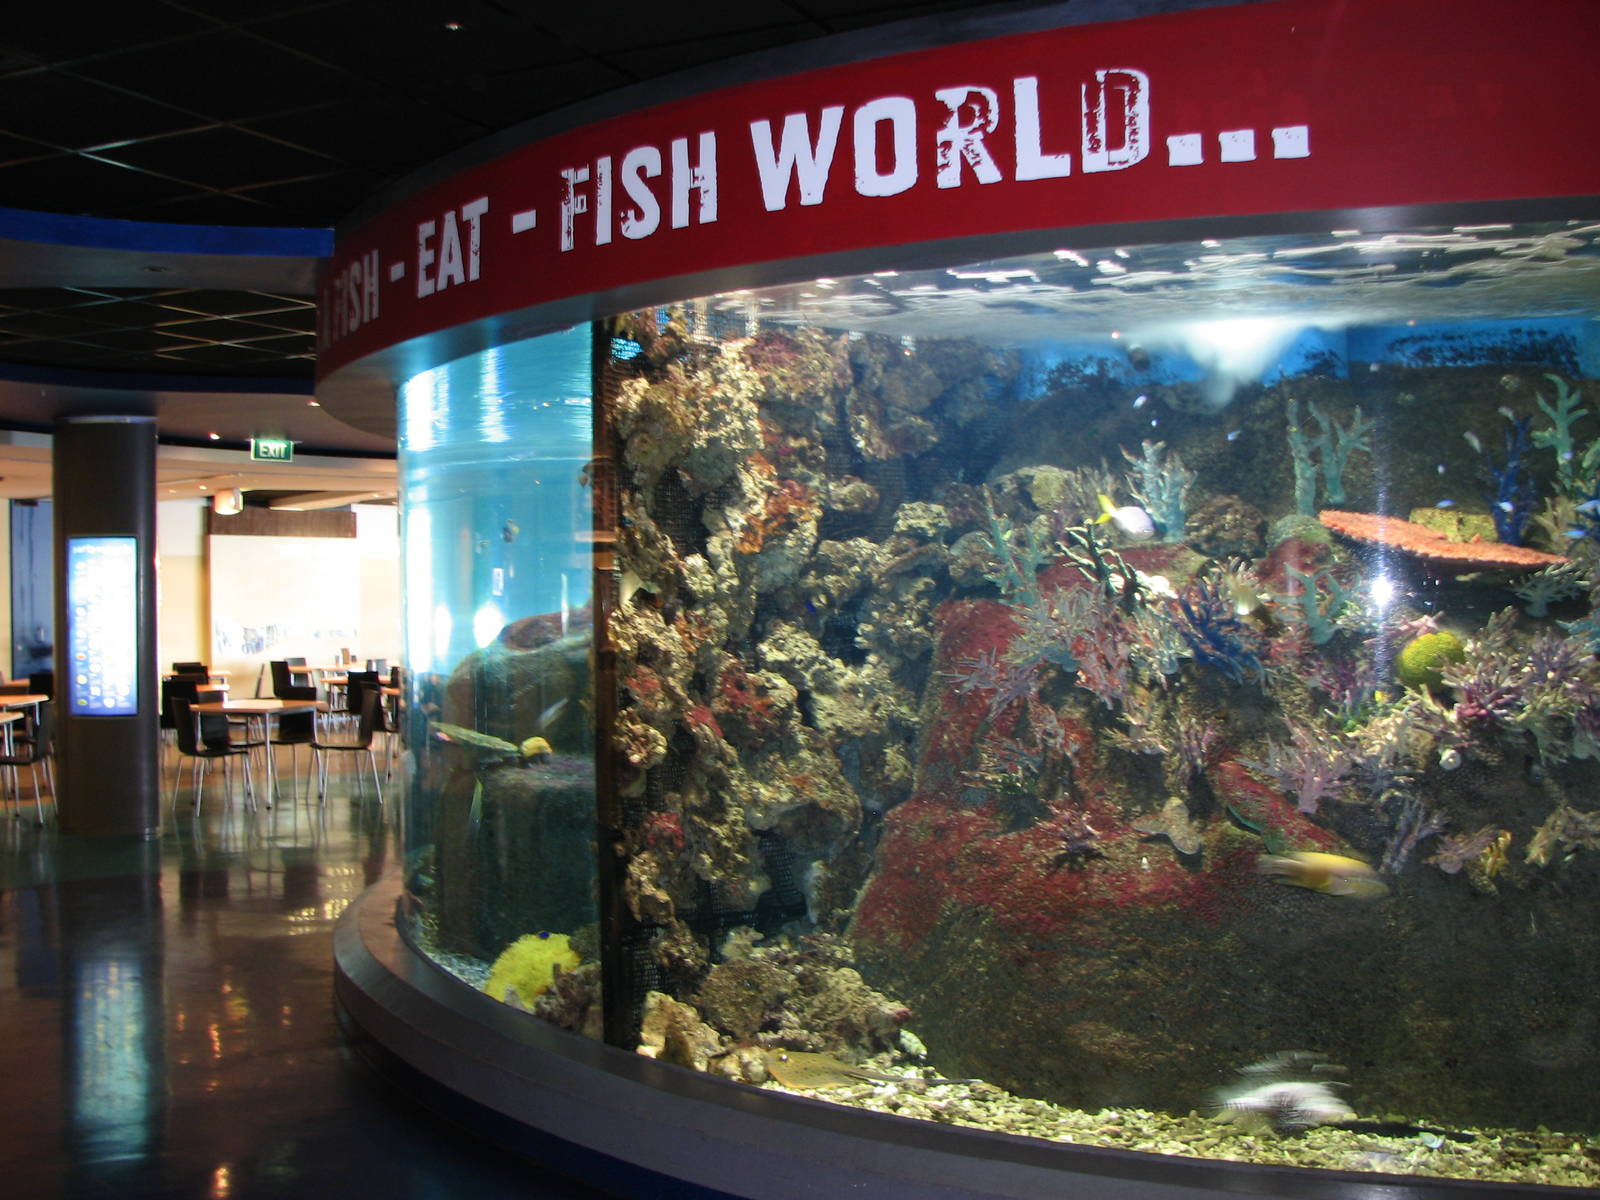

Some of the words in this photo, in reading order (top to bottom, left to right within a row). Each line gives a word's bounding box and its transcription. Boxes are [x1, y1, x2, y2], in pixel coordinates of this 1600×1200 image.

[334, 249, 380, 343] FISH
[416, 196, 489, 299] EAT
[560, 130, 718, 253] FISH
[259, 441, 288, 459] EXIT
